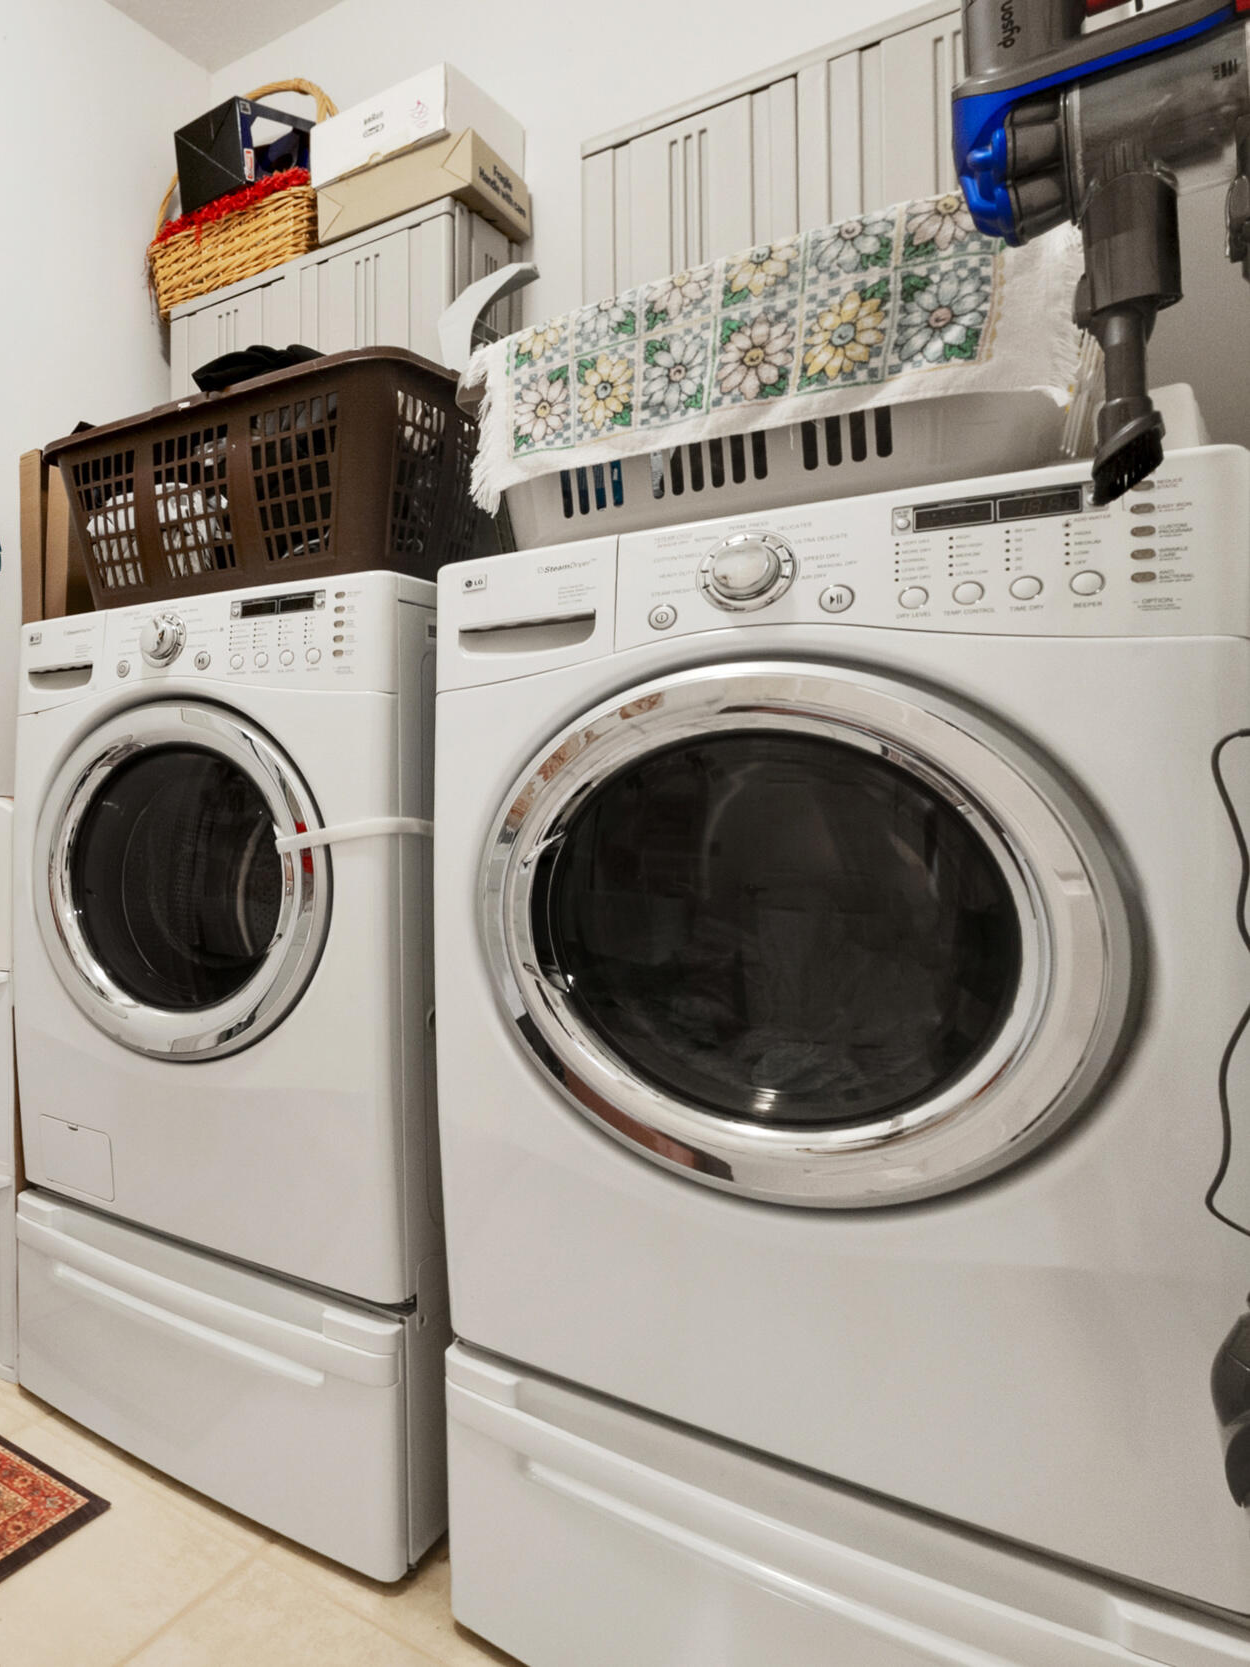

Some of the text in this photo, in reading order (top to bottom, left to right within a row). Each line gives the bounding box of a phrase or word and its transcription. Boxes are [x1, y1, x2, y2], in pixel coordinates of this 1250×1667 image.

[998, 0, 1022, 48] dyson
[478, 166, 500, 195] Handle
[493, 164, 513, 192] Fragile
[963, 607, 996, 616] CONTROL
